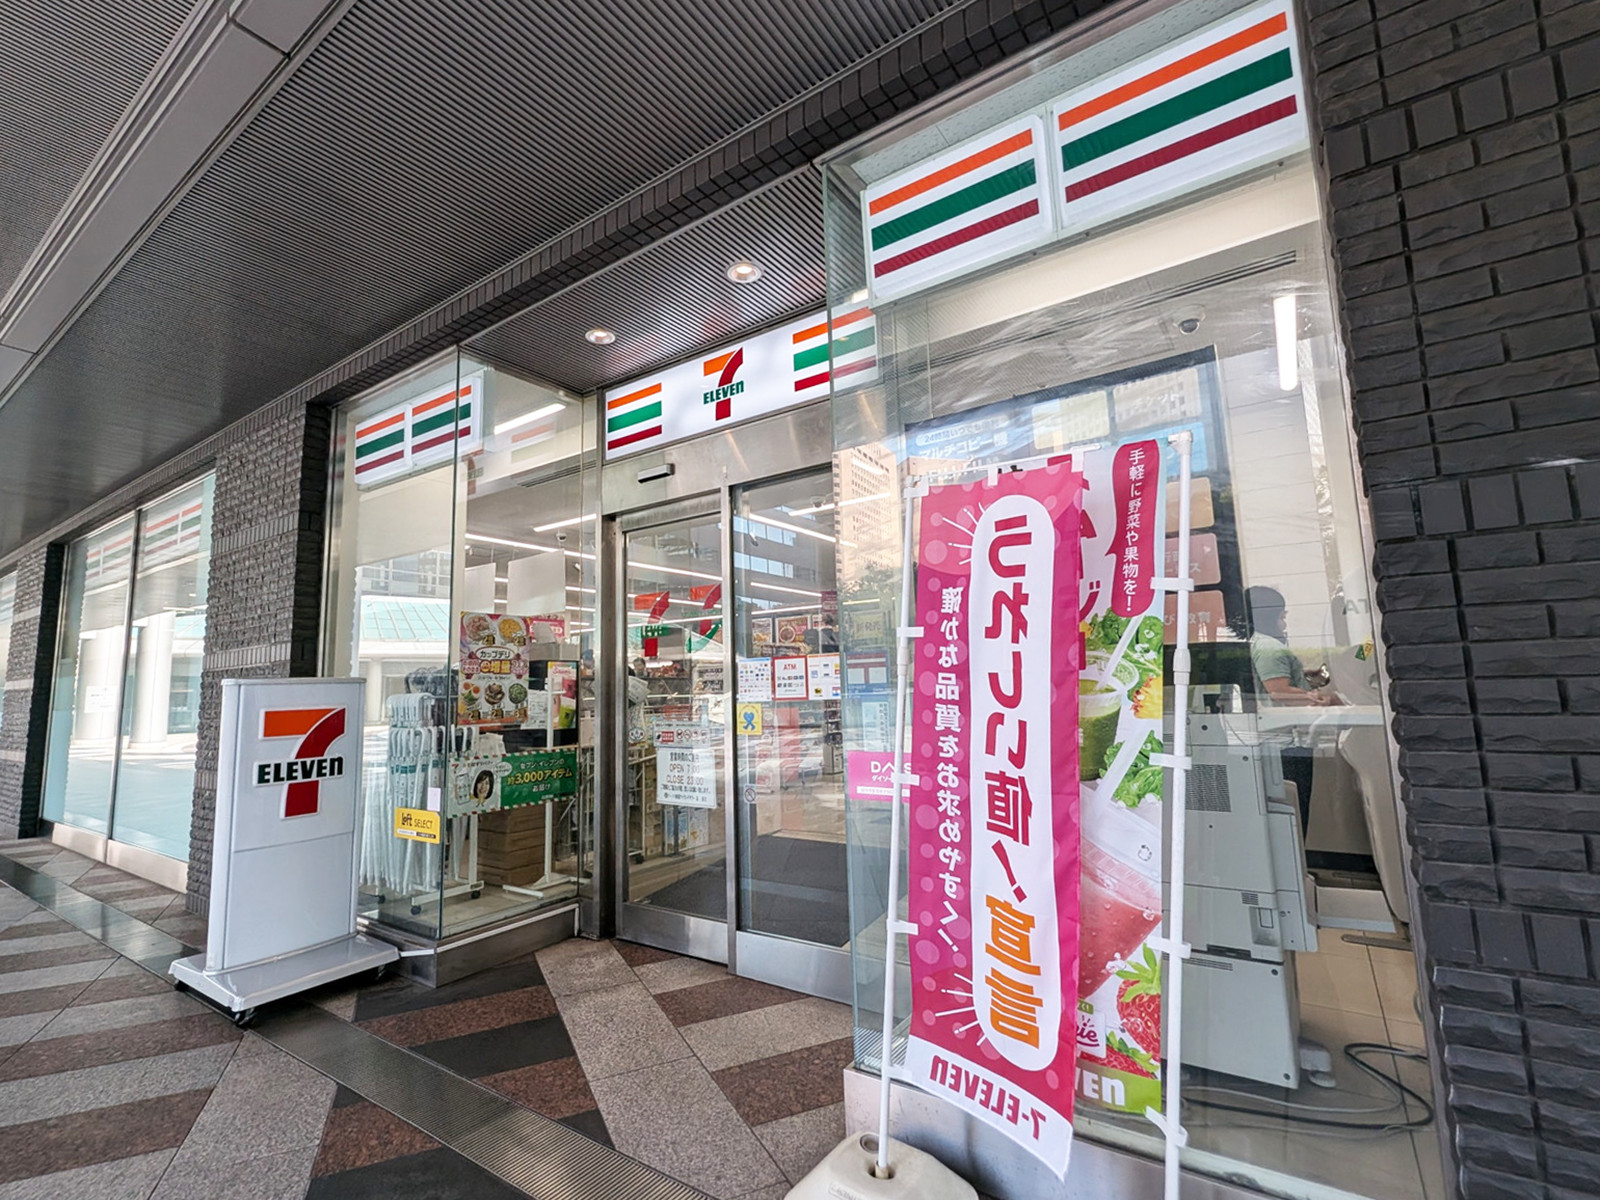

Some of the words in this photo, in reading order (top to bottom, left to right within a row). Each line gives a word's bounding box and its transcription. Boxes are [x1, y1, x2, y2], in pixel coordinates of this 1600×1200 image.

[783, 663, 797, 671] ATM
[669, 763, 685, 773] OPEN
[666, 774, 685, 785] CLOSE
[414, 818, 433, 830] SELECT
